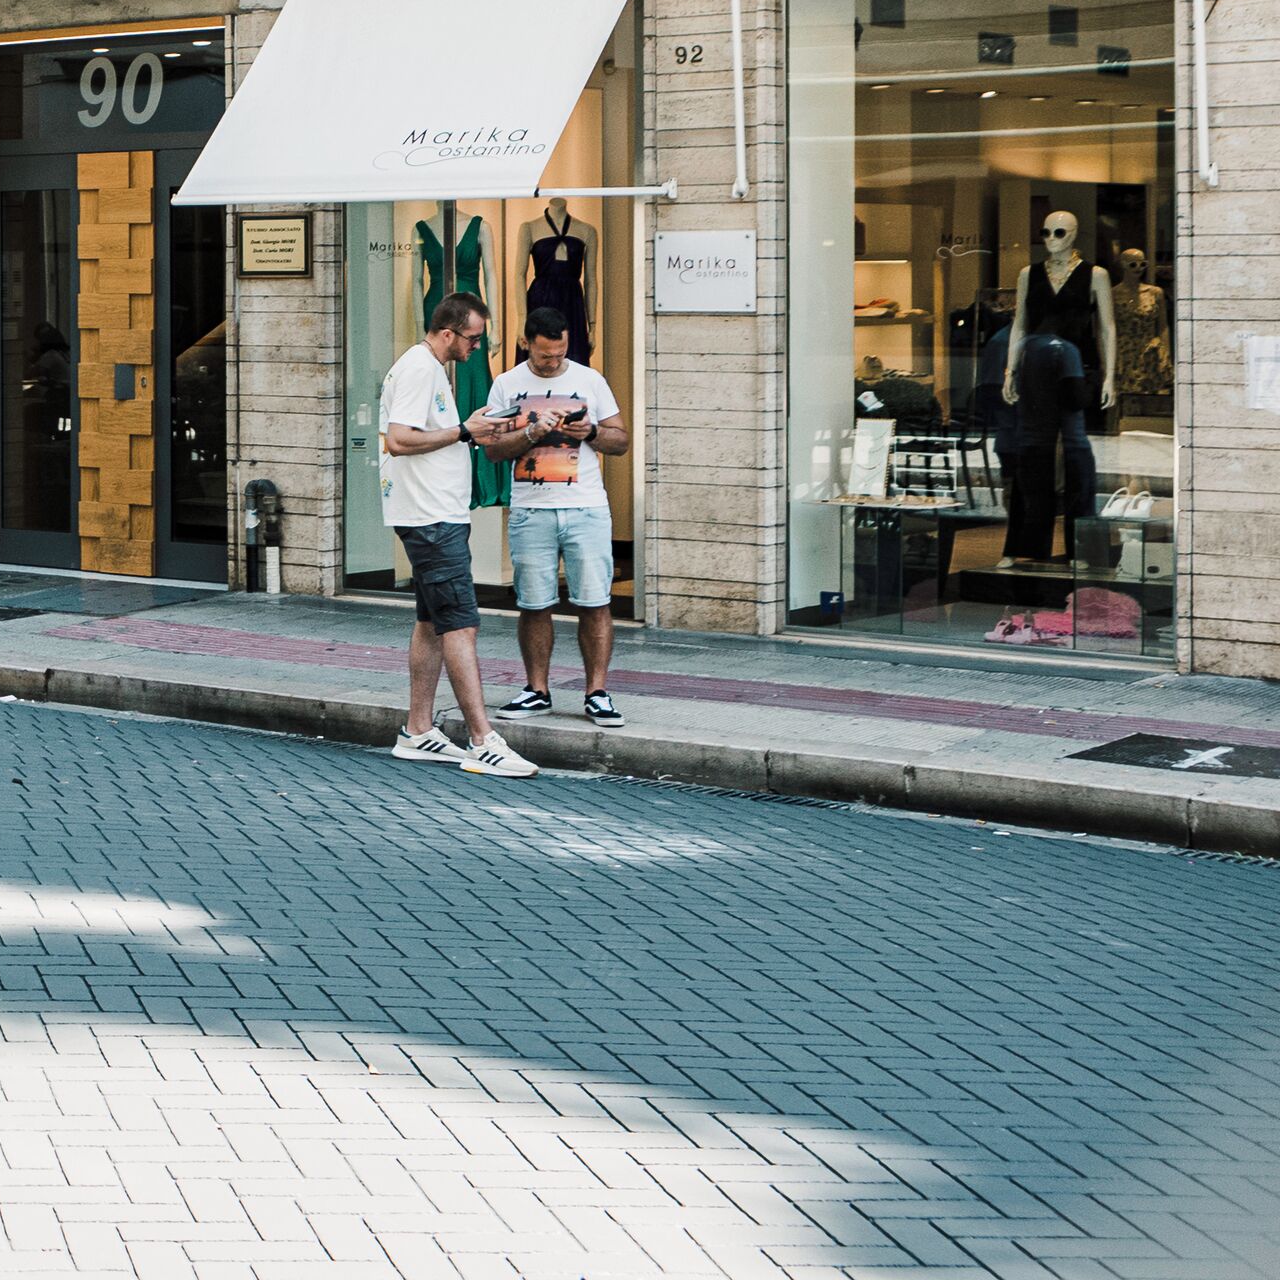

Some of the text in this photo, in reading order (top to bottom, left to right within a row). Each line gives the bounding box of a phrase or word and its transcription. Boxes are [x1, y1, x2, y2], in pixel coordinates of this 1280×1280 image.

[675, 45, 703, 64] 92
[77, 52, 164, 128] 90
[401, 127, 529, 146] Marika
[369, 241, 412, 252] Marika
[667, 256, 736, 270] Marika
